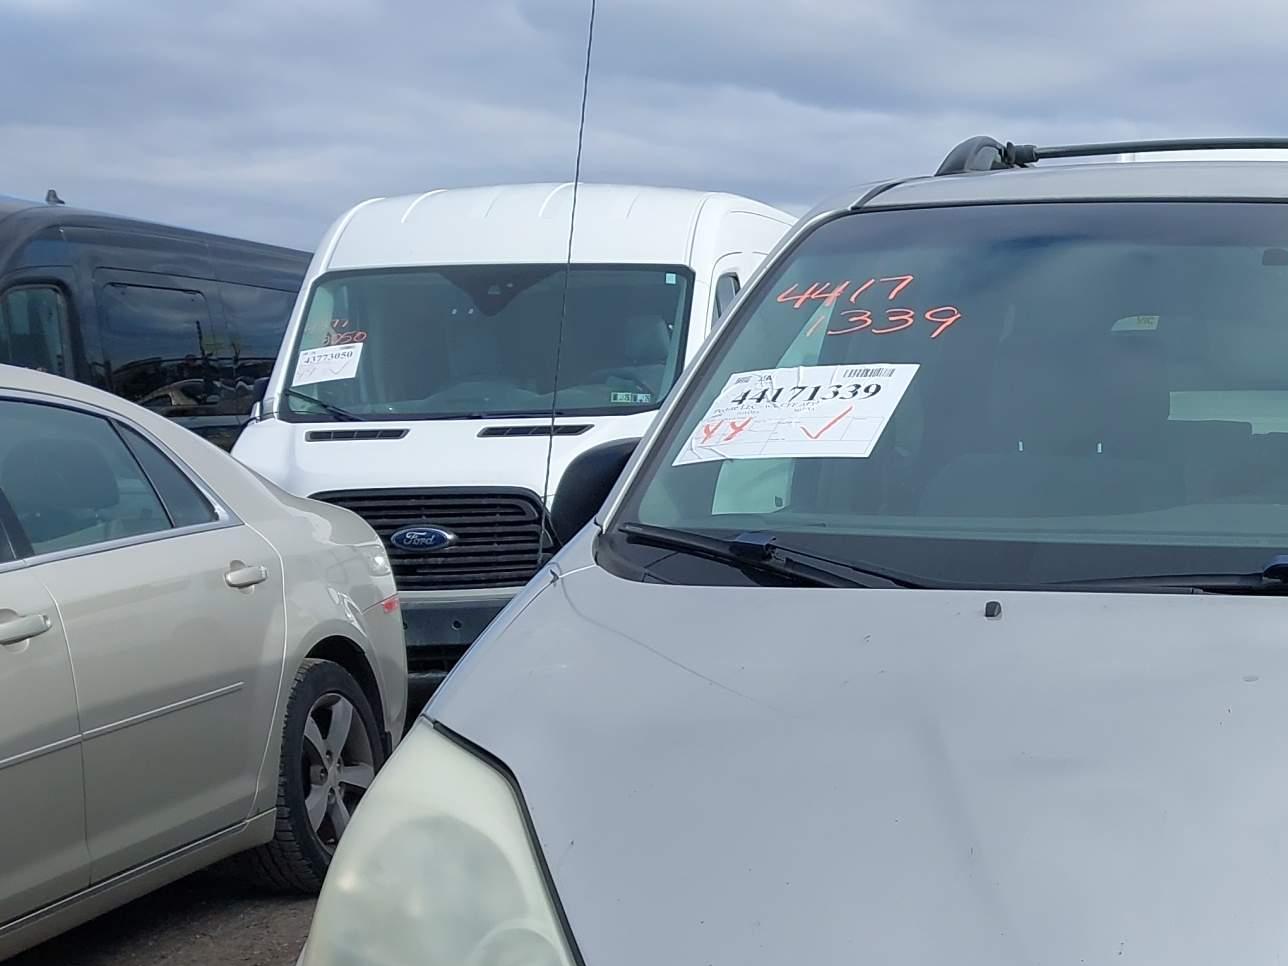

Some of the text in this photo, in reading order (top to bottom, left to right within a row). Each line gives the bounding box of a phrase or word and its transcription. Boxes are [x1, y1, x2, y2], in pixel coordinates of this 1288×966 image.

[776, 274, 914, 309] 4417
[805, 305, 962, 339] 1339
[731, 382, 882, 406] 44171339
[402, 531, 436, 545] Ford
